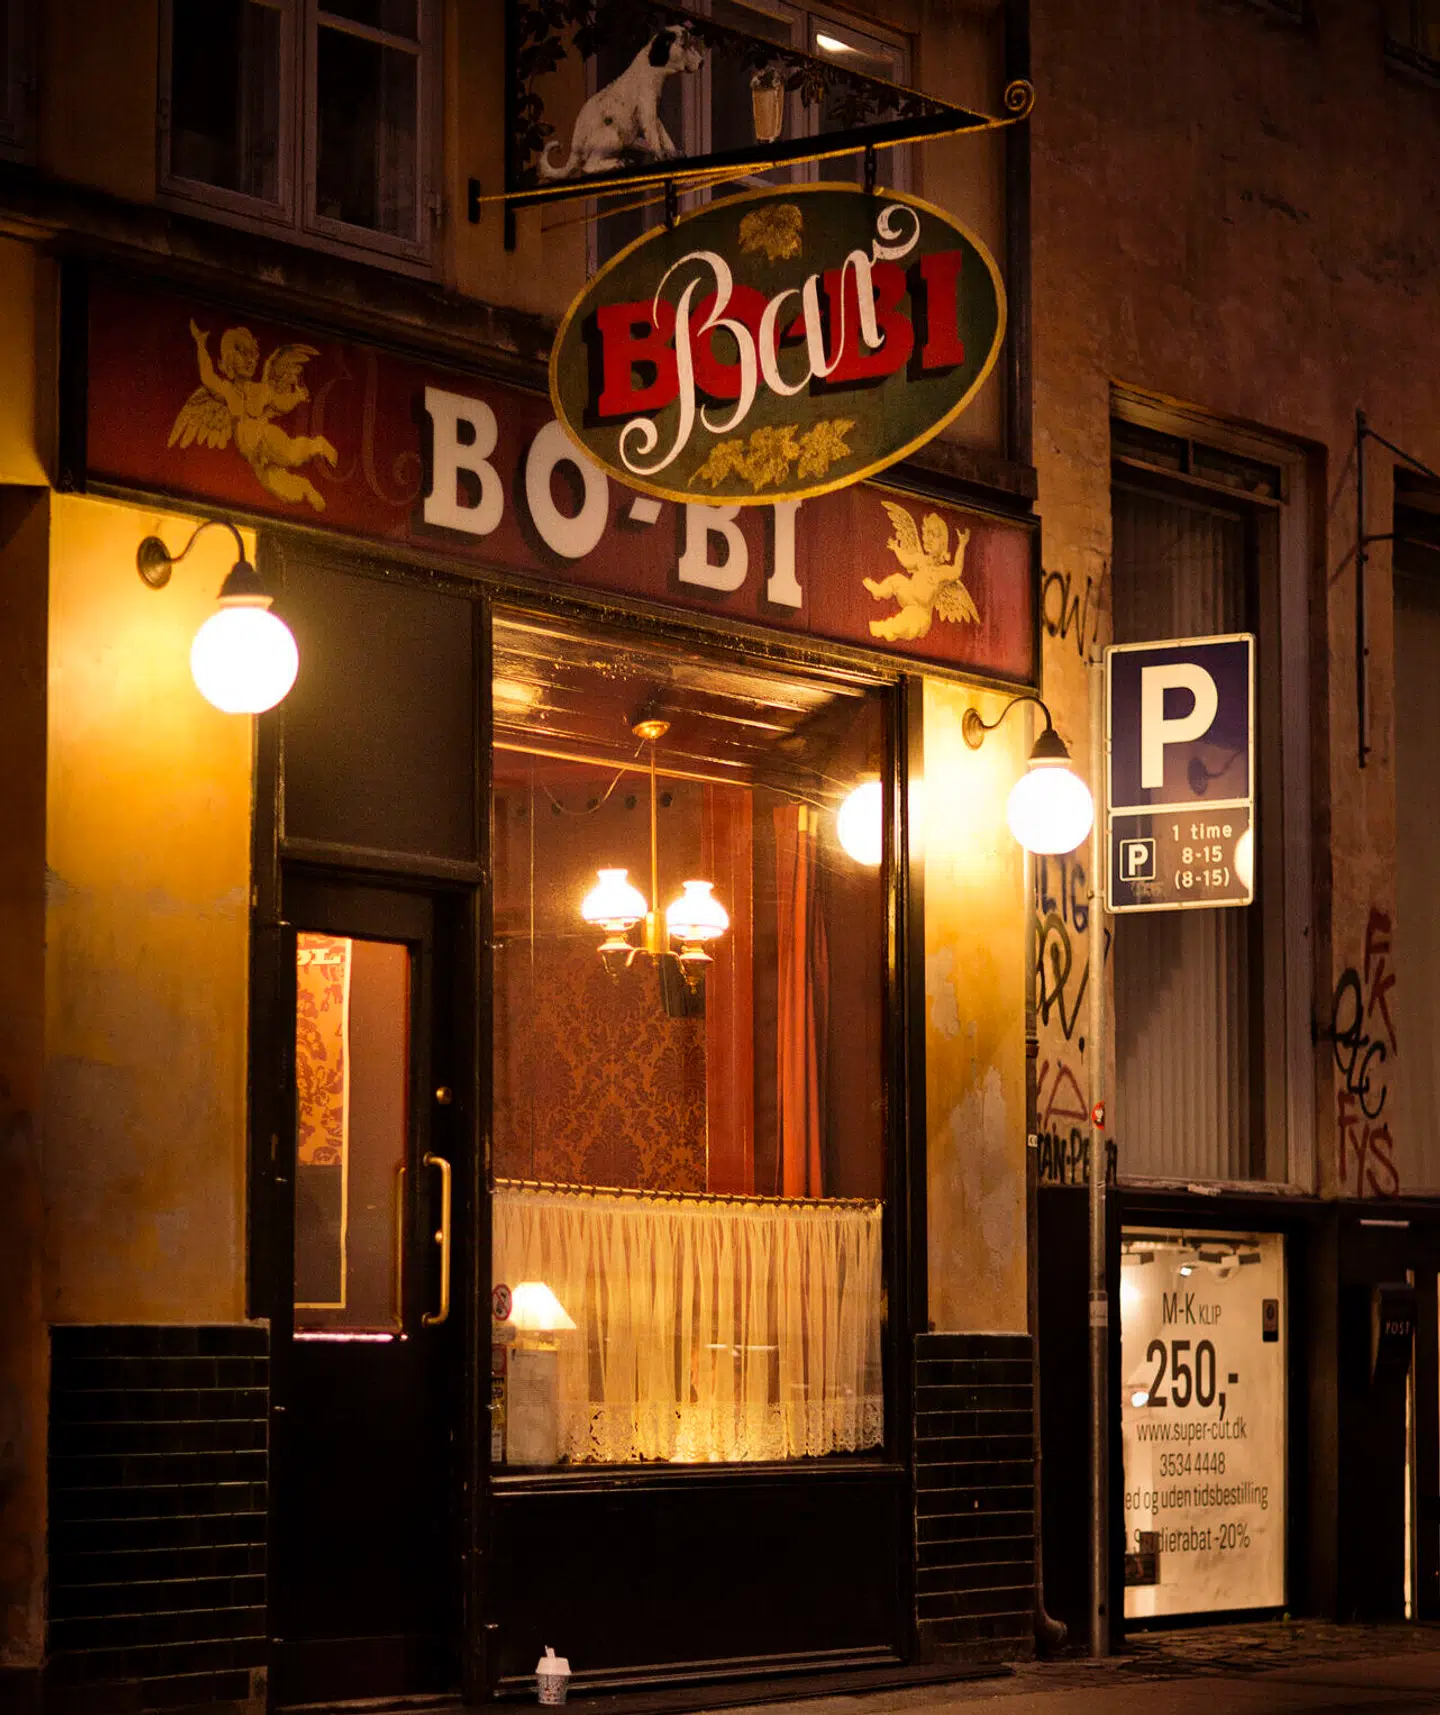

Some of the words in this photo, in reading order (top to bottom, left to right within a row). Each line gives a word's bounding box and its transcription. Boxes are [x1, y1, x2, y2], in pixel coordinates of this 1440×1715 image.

[619, 204, 921, 476] Bar
[424, 385, 803, 609] BO-BI
[1141, 662, 1218, 789] P
[1172, 824, 1179, 842] 1
[1190, 822, 1233, 840] time
[1128, 843, 1149, 876] P
[1182, 845, 1223, 864] 8-15
[1175, 867, 1230, 889] (8-15)
[1162, 1292, 1197, 1325] M-K
[1199, 1304, 1222, 1325] KLIP
[1146, 1339, 1239, 1421] 250,-
[1137, 1416, 1248, 1446] www.super-cut.dk
[1125, 1486, 1141, 1510] ed
[1144, 1490, 1159, 1515] og
[1161, 1484, 1191, 1509] uden
[1193, 1481, 1269, 1510] tidsbestilling
[1214, 1522, 1251, 1550] -20%
